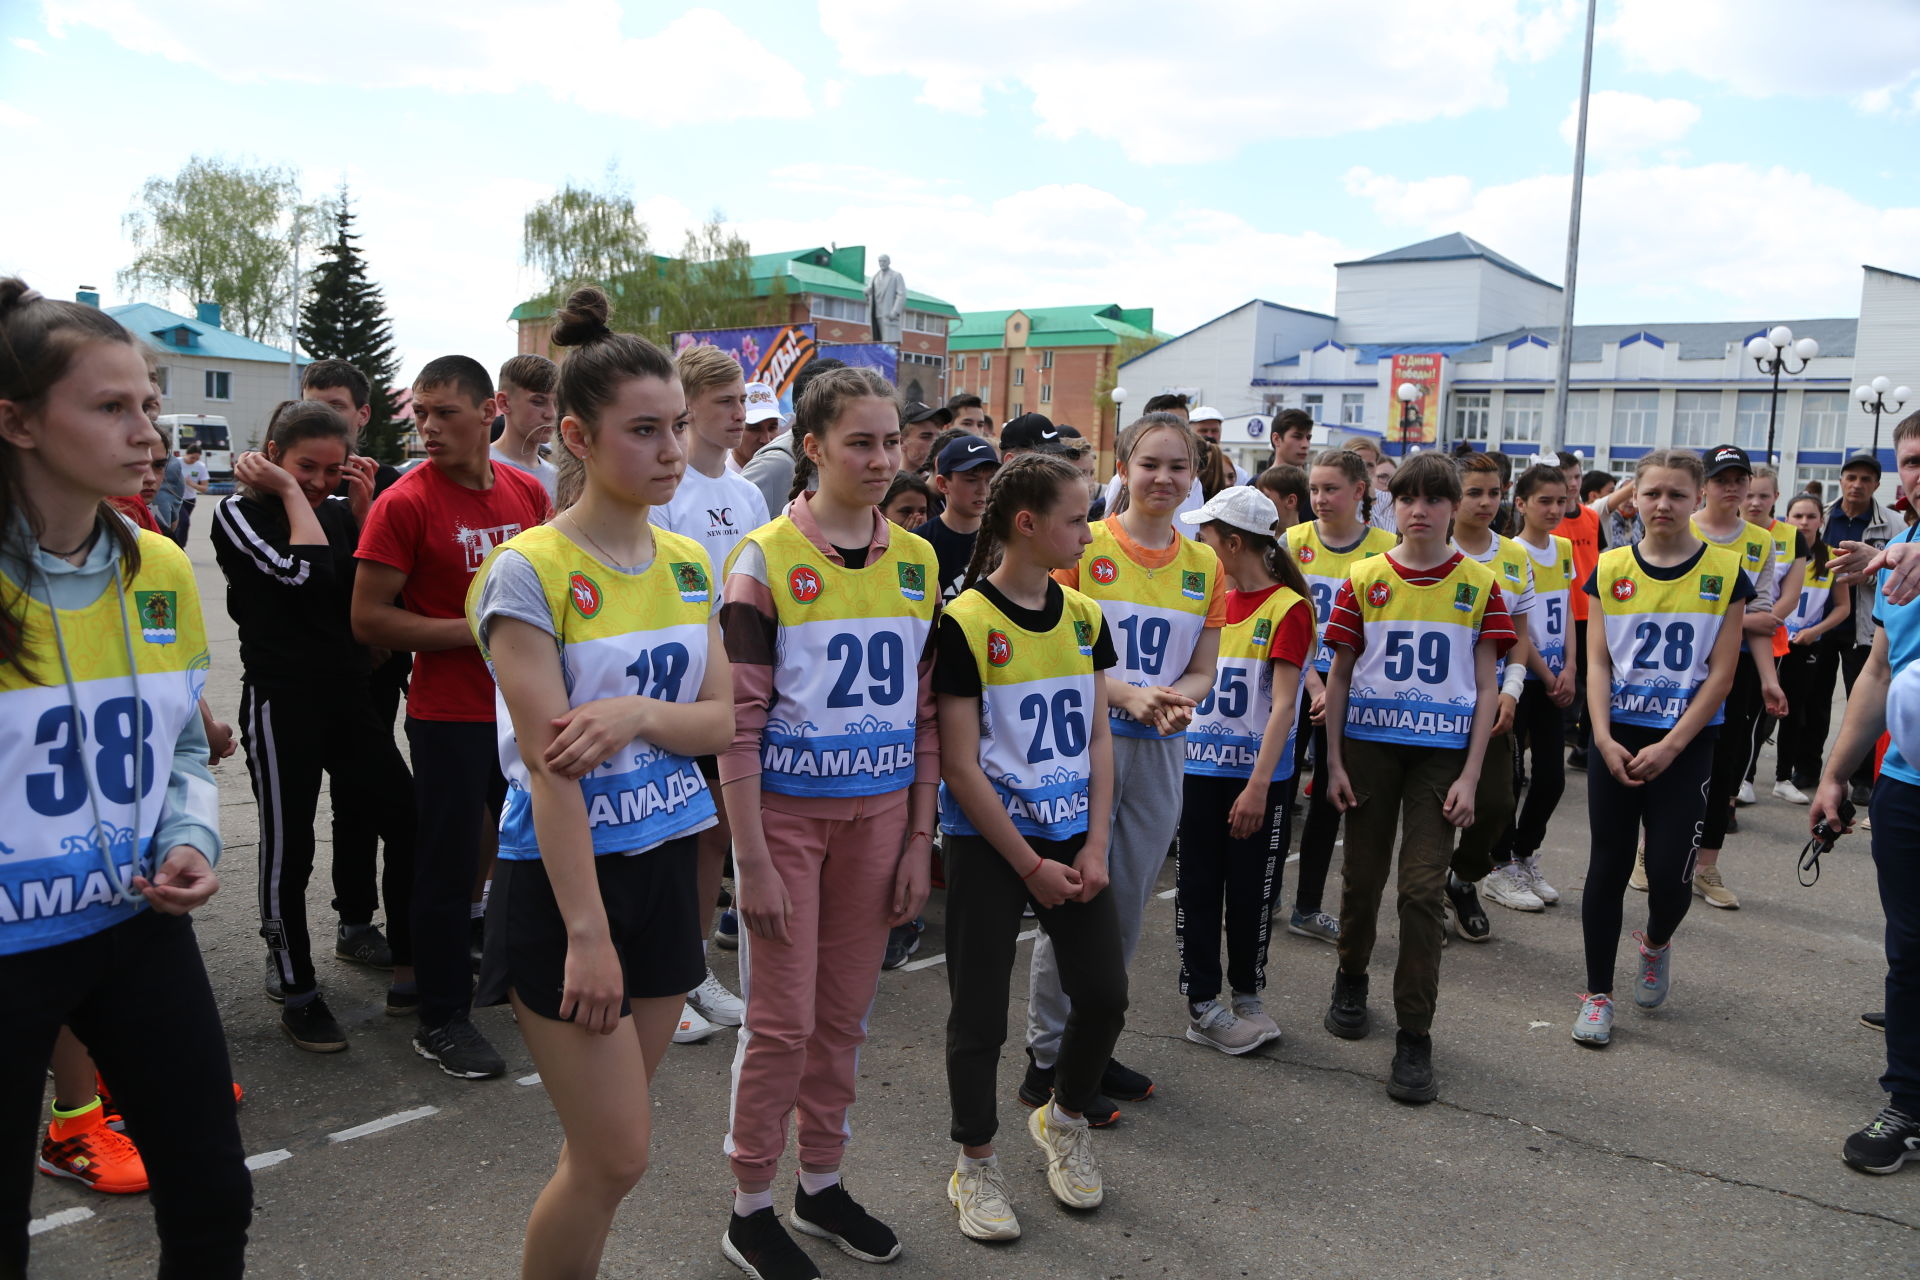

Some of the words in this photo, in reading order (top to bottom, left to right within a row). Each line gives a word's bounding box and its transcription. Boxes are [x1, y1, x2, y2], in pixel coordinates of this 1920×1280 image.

[706, 507, 734, 527] NC
[1310, 582, 1341, 624] 3
[1546, 598, 1562, 634] 5
[626, 642, 690, 702] 18
[827, 630, 904, 708] 29
[1118, 614, 1171, 675] 19
[1384, 630, 1451, 684] 59
[1632, 621, 1695, 671] 28
[1020, 688, 1087, 764] 26
[26, 696, 155, 817] 38
